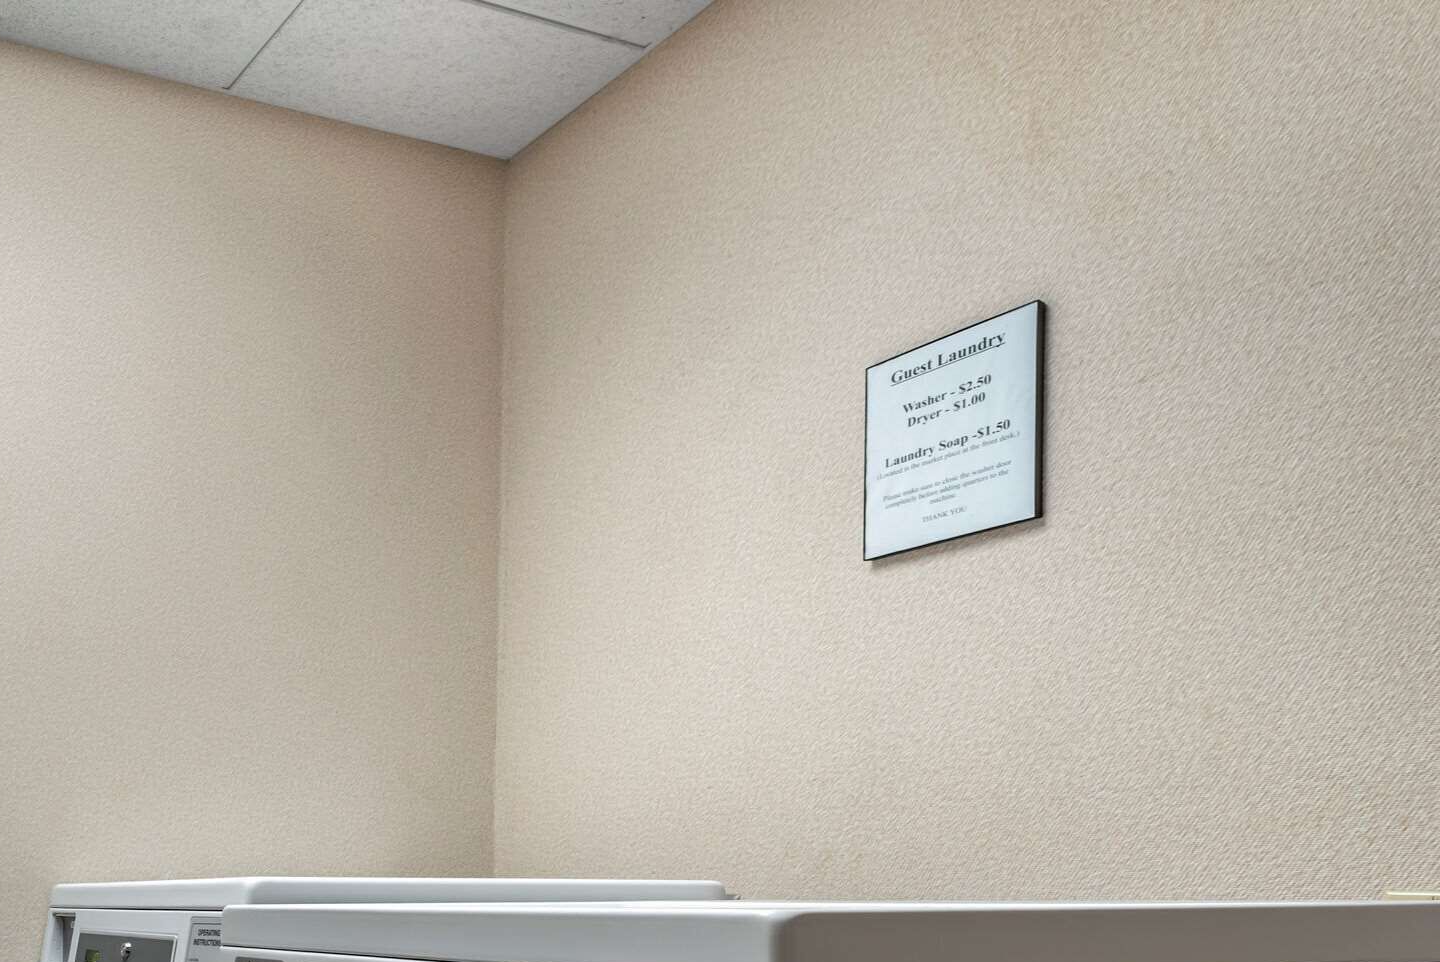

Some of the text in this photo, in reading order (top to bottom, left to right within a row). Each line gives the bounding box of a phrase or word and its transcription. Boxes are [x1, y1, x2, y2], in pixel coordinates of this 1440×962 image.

[890, 332, 1006, 383] Guest Laundry
[903, 392, 947, 413] Washer
[959, 374, 991, 394] $2.50
[908, 409, 942, 427] Dryer
[954, 392, 985, 411] $1.00
[885, 446, 935, 468] Laundry
[939, 435, 968, 451] Soap
